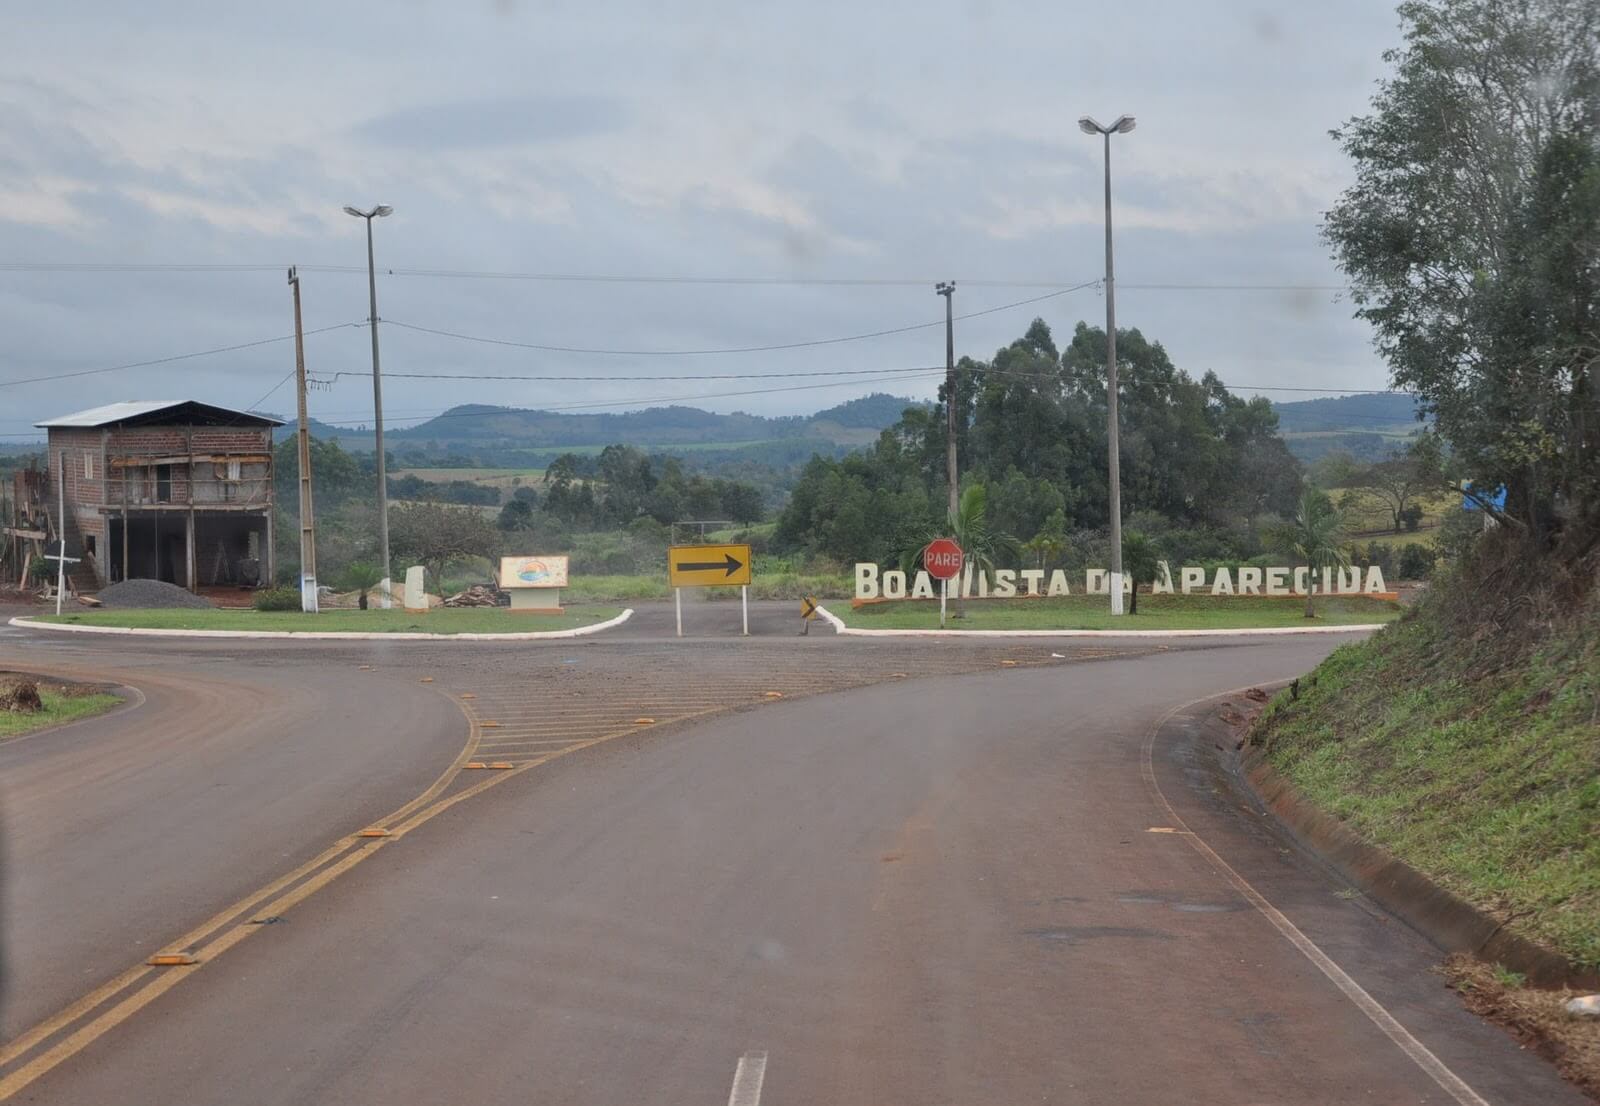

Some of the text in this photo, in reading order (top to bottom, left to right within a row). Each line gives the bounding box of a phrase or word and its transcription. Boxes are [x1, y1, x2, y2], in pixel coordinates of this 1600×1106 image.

[926, 552, 960, 567] PARE
[855, 563, 934, 599] BOA
[1152, 560, 1387, 595] APARECIDA
